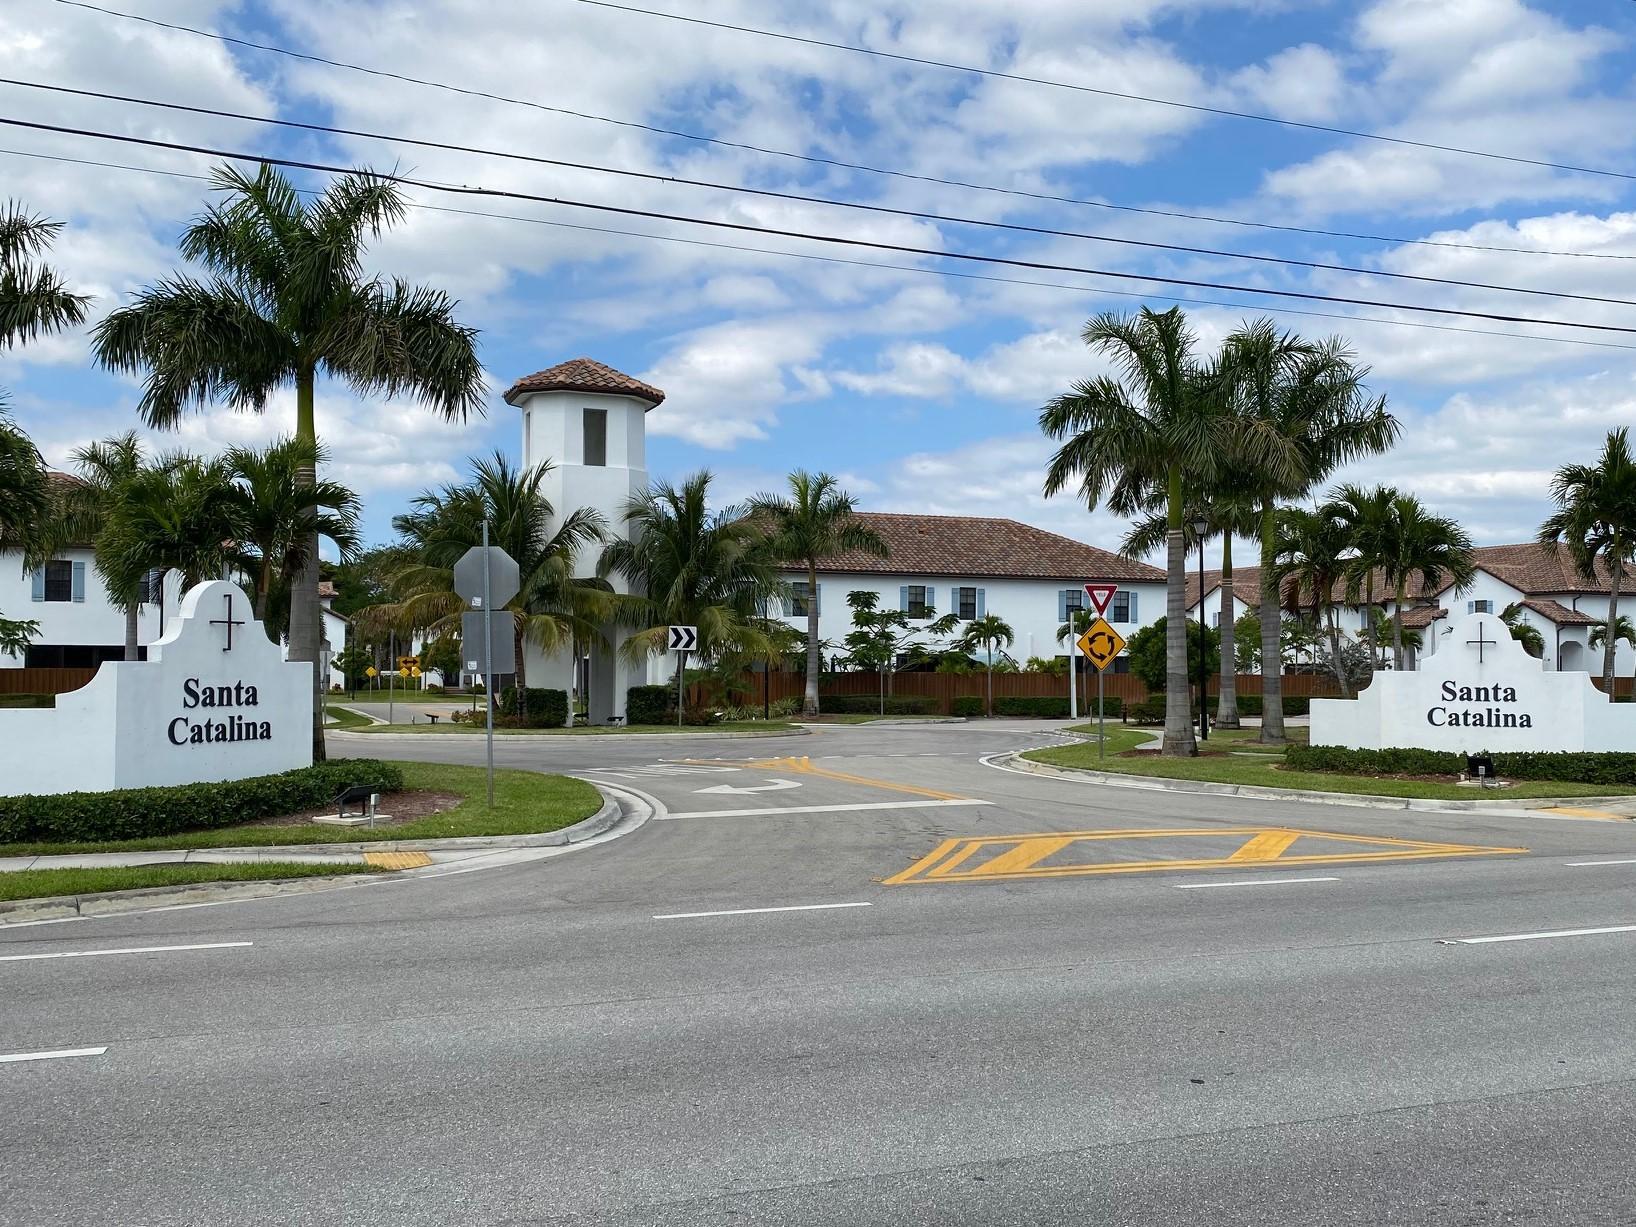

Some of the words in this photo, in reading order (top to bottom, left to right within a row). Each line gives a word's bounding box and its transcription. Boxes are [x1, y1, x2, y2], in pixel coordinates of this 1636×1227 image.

[183, 678, 259, 709] Santa
[1441, 680, 1518, 703] Santa
[167, 715, 272, 746] Catalina
[1427, 707, 1533, 728] Catalina
